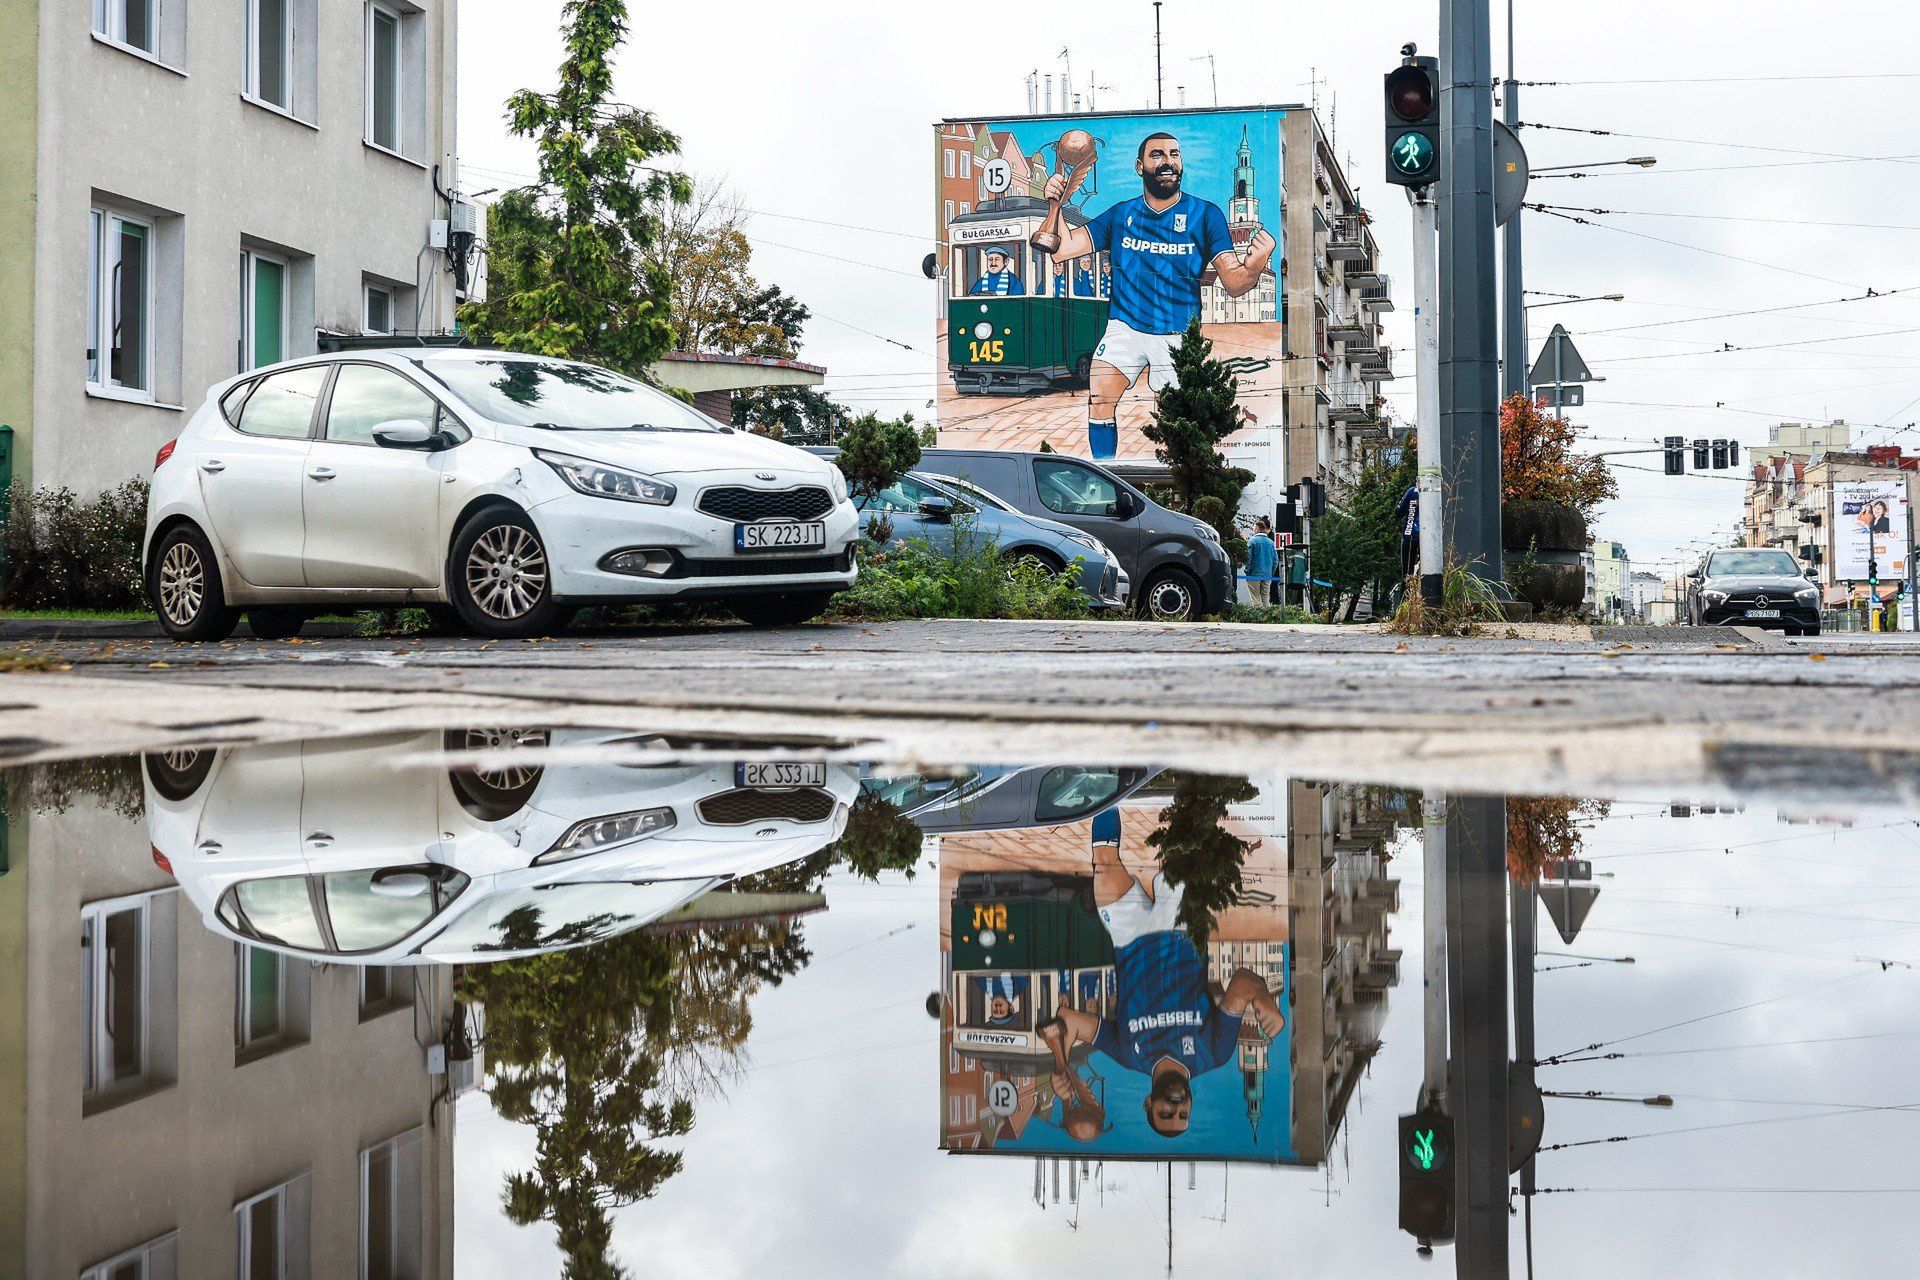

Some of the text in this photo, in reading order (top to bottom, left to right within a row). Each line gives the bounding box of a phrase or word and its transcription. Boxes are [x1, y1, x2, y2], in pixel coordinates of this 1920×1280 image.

[988, 167, 1004, 187] 15
[962, 228, 1010, 239] BUŁGARSKA
[1121, 236, 1195, 255] SUPERBET
[969, 340, 1004, 362] 145
[1096, 343, 1106, 357] 9
[747, 526, 768, 546] SK
[774, 525, 820, 545] 223JT
